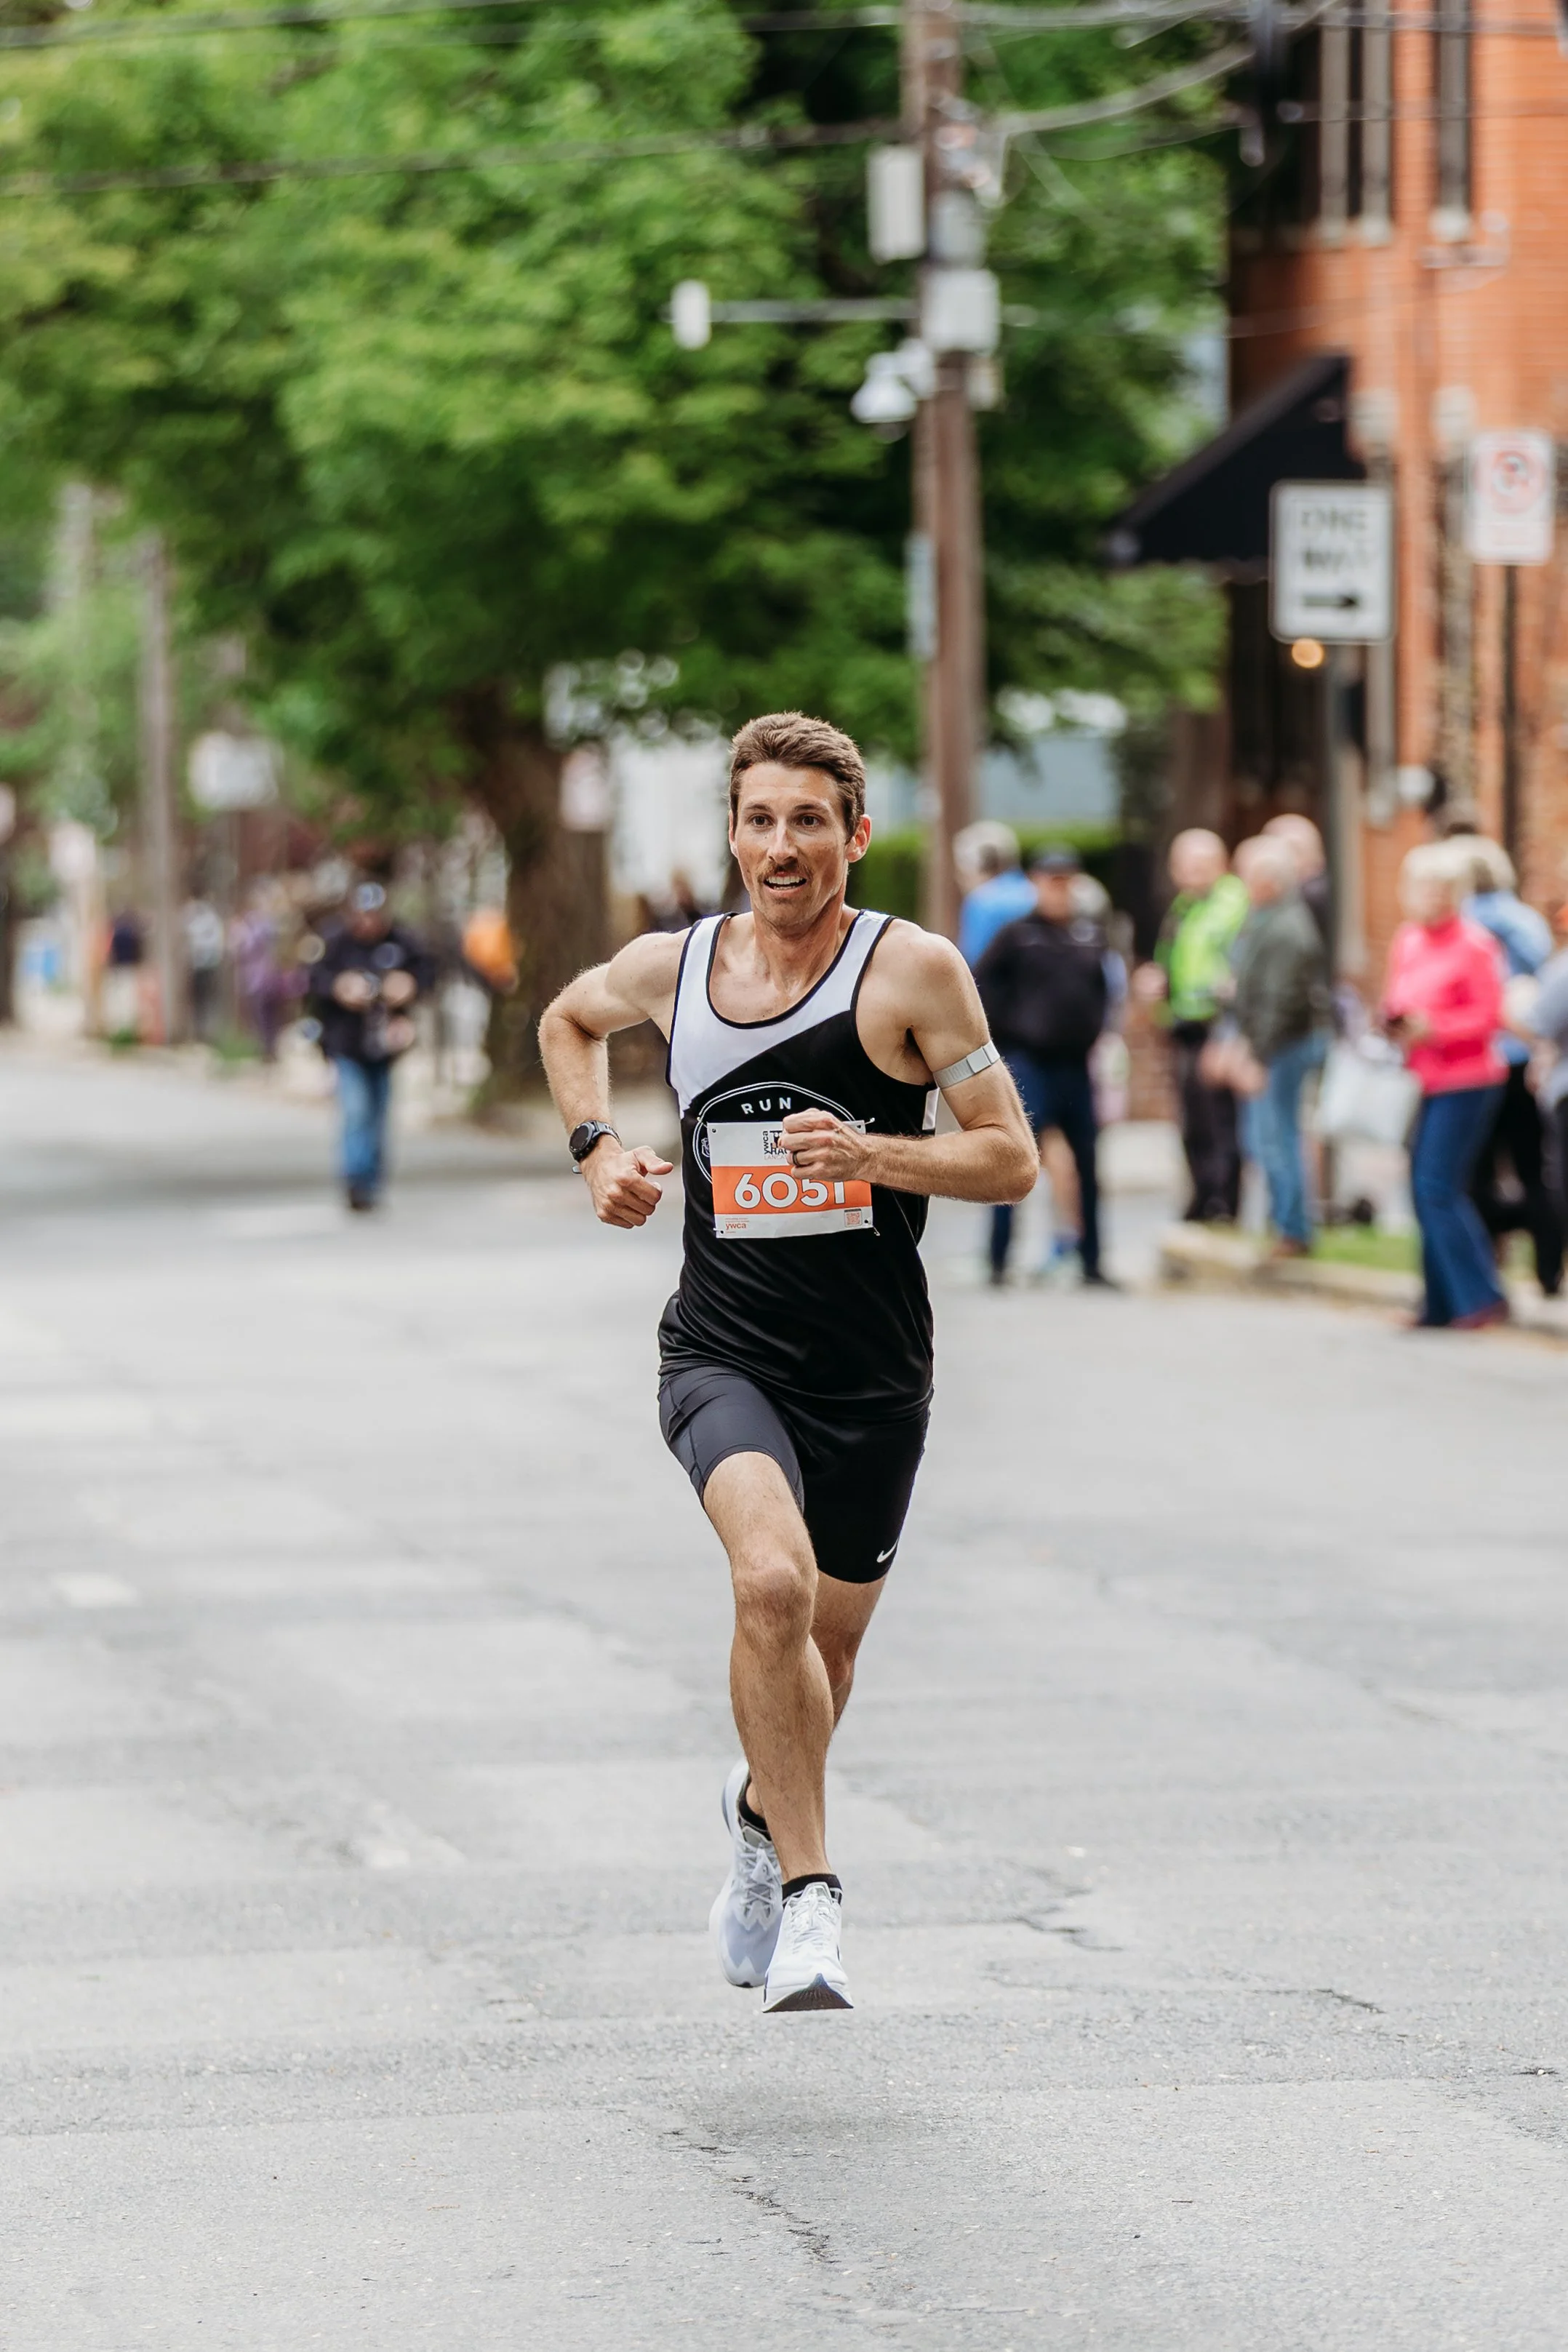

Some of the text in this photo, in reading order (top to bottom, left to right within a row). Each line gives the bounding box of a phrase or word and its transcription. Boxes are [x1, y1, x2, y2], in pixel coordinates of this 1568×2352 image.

[741, 1097, 792, 1114] RUN
[763, 1130, 771, 1155] ywca
[734, 1172, 846, 1209] 6051
[725, 1223, 747, 1231] ywca
